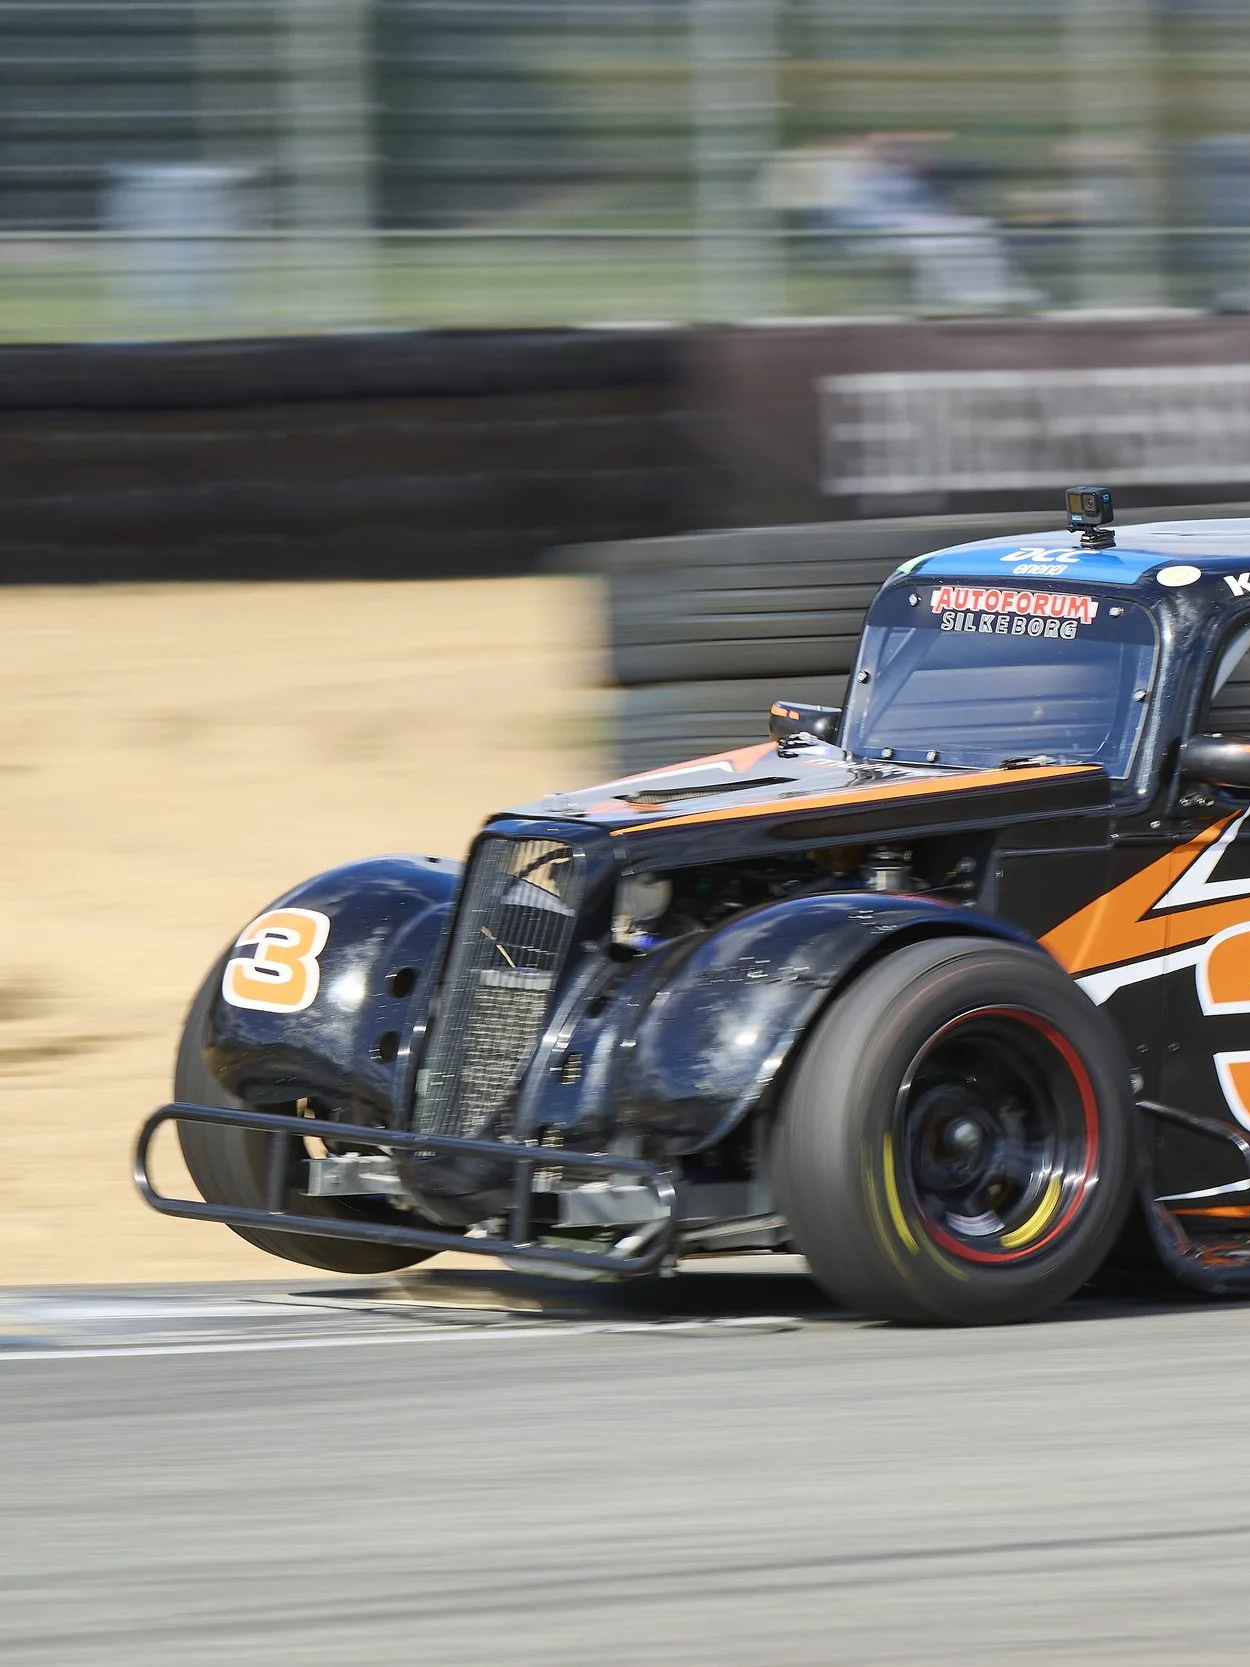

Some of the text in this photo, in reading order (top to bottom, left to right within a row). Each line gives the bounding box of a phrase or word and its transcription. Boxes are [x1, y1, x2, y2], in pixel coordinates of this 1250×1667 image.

[1000, 547, 1102, 562] DCC
[931, 587, 1093, 625] AUTOFORUM
[940, 611, 1078, 640] SILKEBORG
[221, 907, 331, 1014] 3
